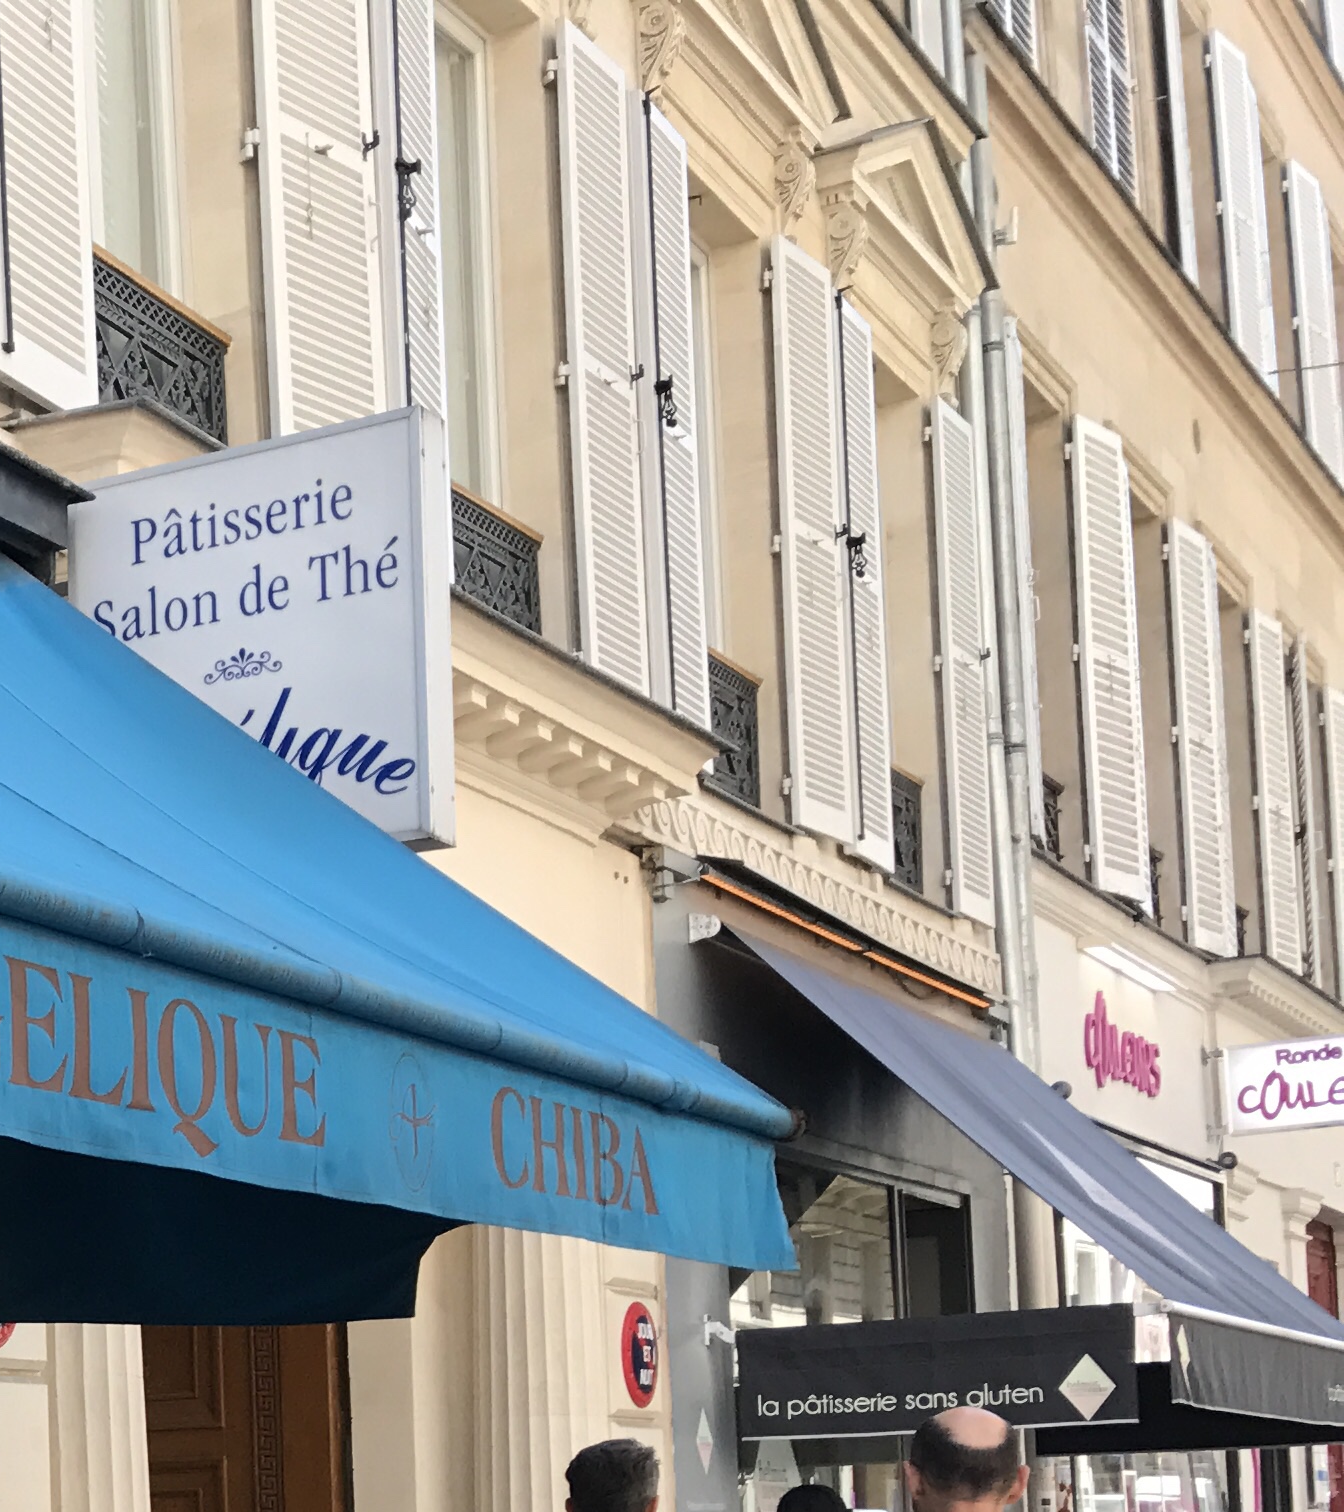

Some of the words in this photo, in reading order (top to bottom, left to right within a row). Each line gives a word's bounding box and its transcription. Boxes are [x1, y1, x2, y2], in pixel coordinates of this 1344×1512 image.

[130, 478, 354, 566] Pâtisserie
[93, 586, 221, 643] Salon
[239, 564, 290, 618] de
[308, 536, 400, 601] Thé
[1275, 1043, 1343, 1066] Ronde
[489, 1085, 660, 1217] CHIBA
[757, 1394, 780, 1418] la
[787, 1392, 898, 1420] pâtisserie
[904, 1392, 958, 1411] sans
[965, 1383, 1044, 1409] gluten
